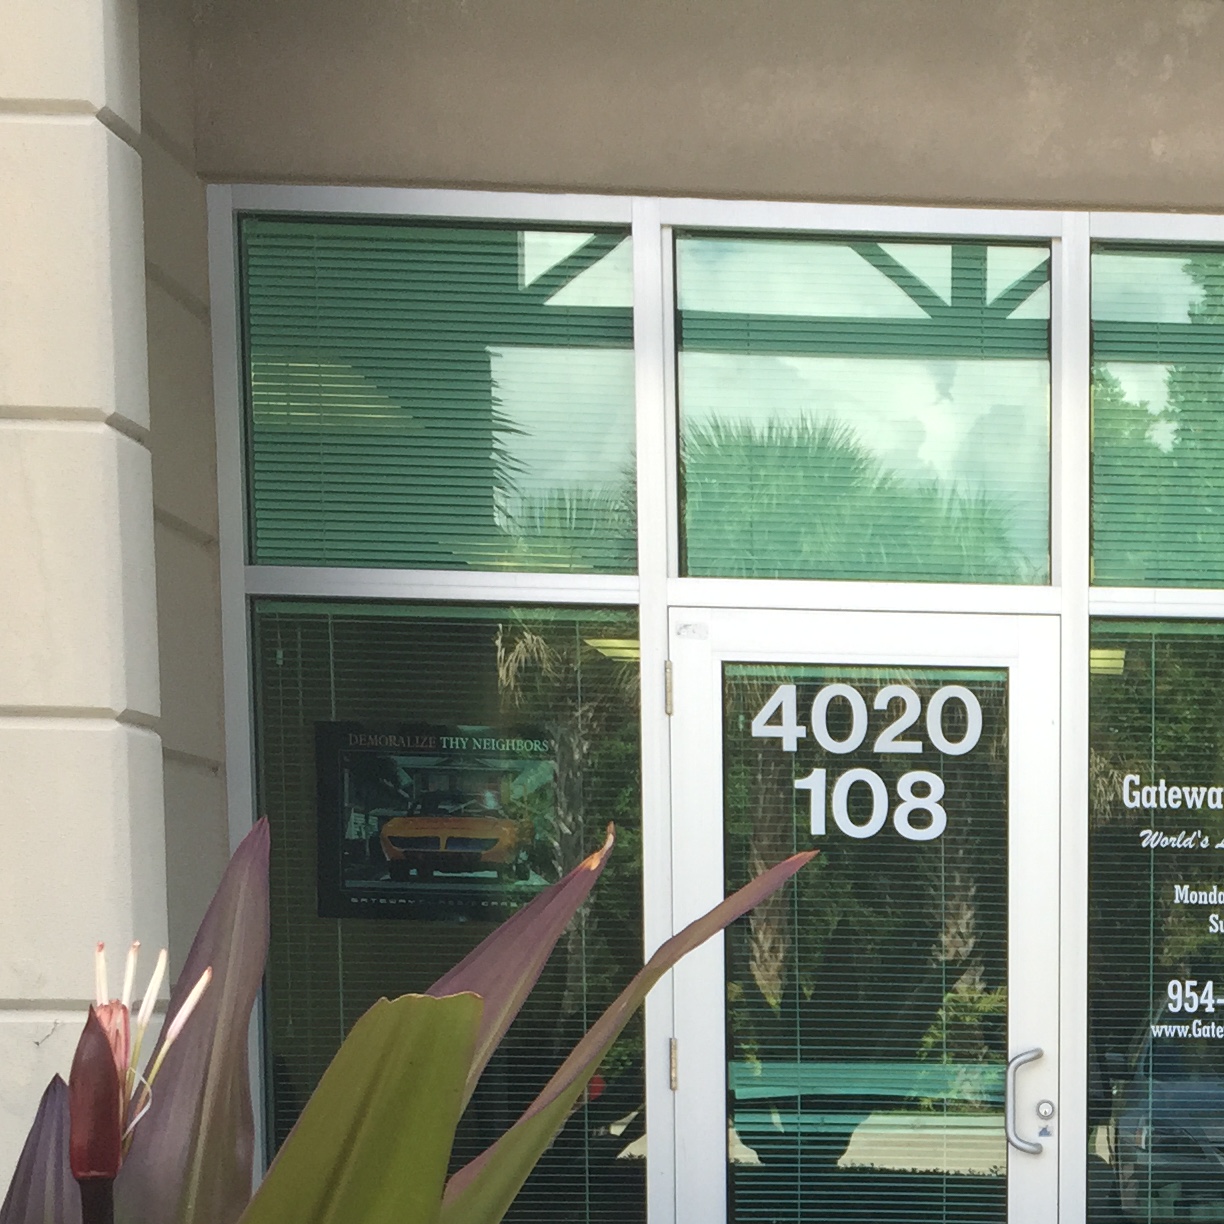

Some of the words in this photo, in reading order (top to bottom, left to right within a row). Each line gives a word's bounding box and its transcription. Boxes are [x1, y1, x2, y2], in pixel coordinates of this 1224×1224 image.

[751, 683, 982, 755] 4020
[349, 734, 436, 748] DEMORALIZE
[440, 737, 469, 749] THY
[472, 738, 549, 751] NEIGHBORS
[794, 768, 947, 841] 108
[1139, 829, 1209, 849] World's
